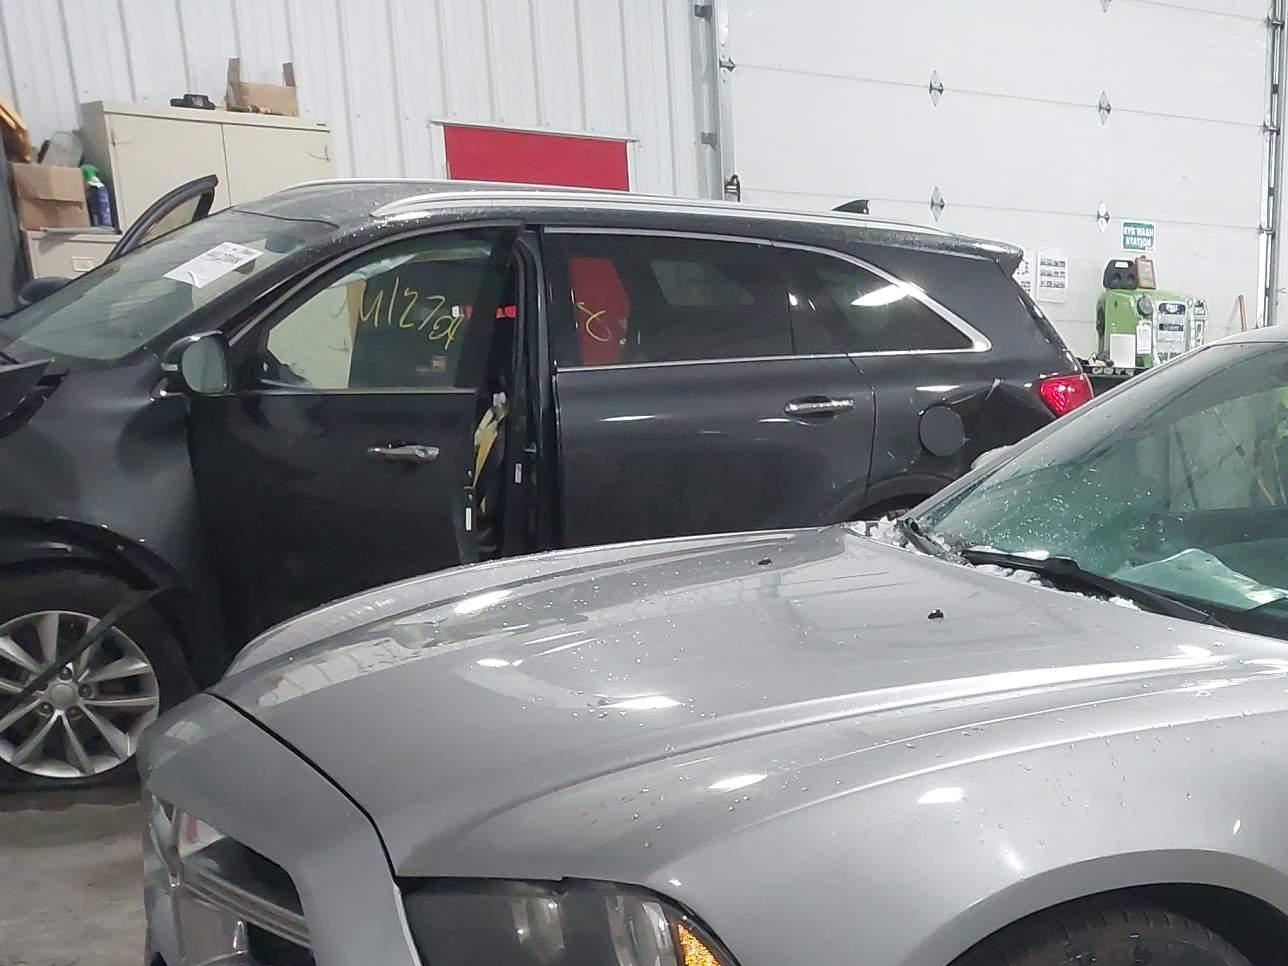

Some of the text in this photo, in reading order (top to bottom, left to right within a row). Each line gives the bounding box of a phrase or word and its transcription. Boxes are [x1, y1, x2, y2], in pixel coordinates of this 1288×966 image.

[1123, 226, 1154, 237] EYE WASH
[1125, 236, 1152, 247] STATION
